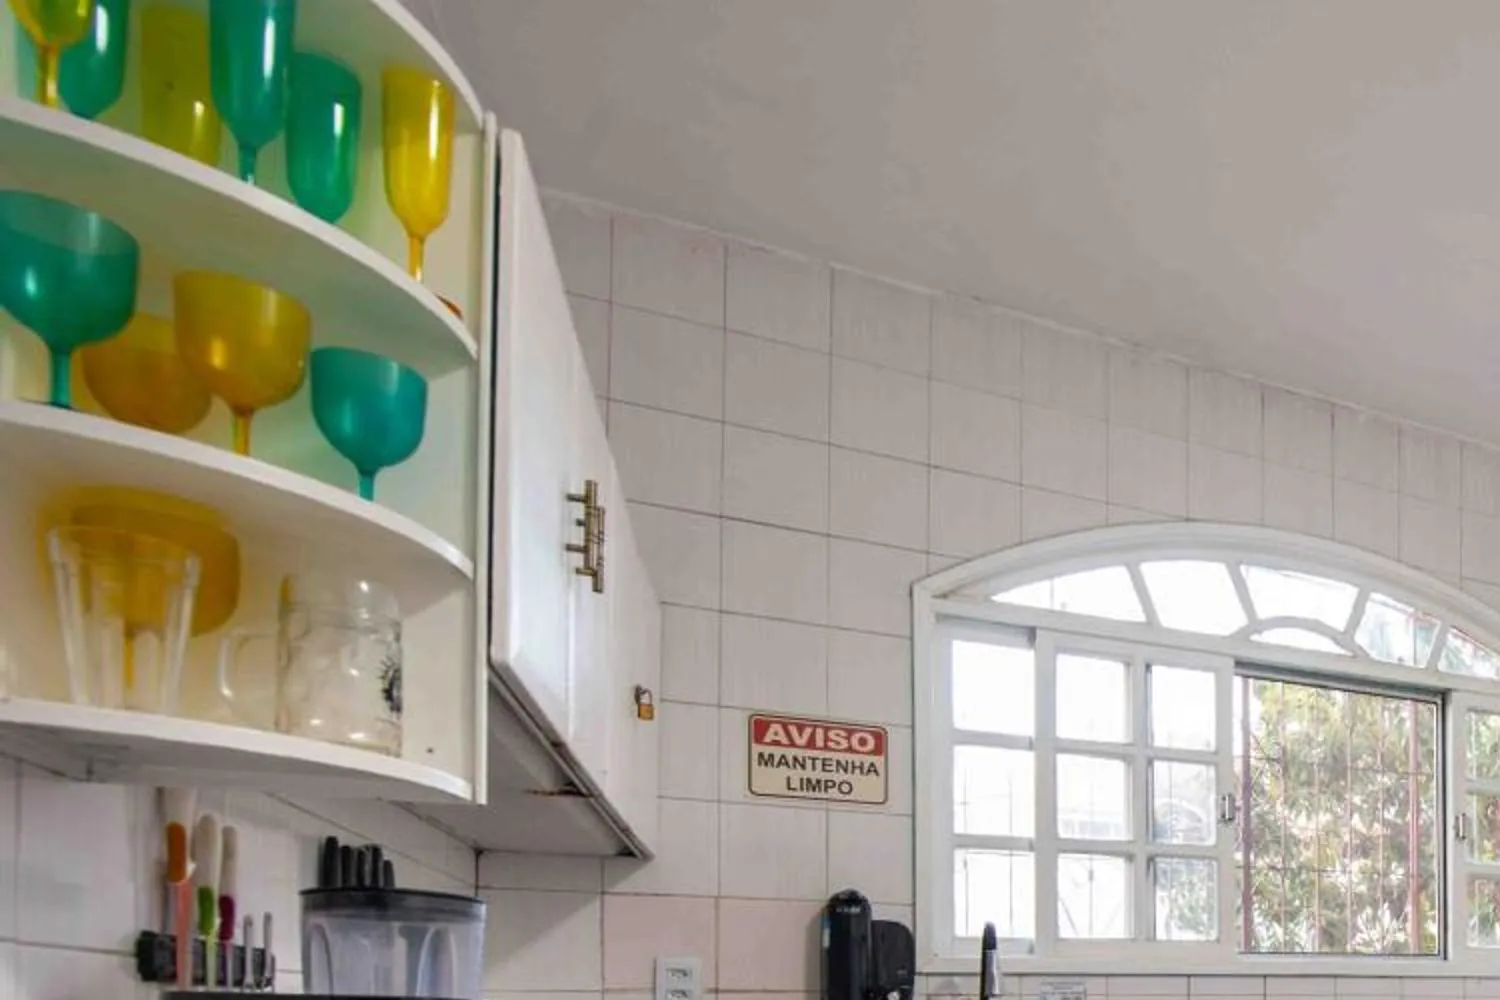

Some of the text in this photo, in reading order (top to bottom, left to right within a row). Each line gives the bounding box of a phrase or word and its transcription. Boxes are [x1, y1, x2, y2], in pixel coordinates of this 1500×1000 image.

[763, 723, 875, 753] AVISO
[757, 751, 880, 777] MANTENHA
[786, 775, 853, 795] LIMPO
